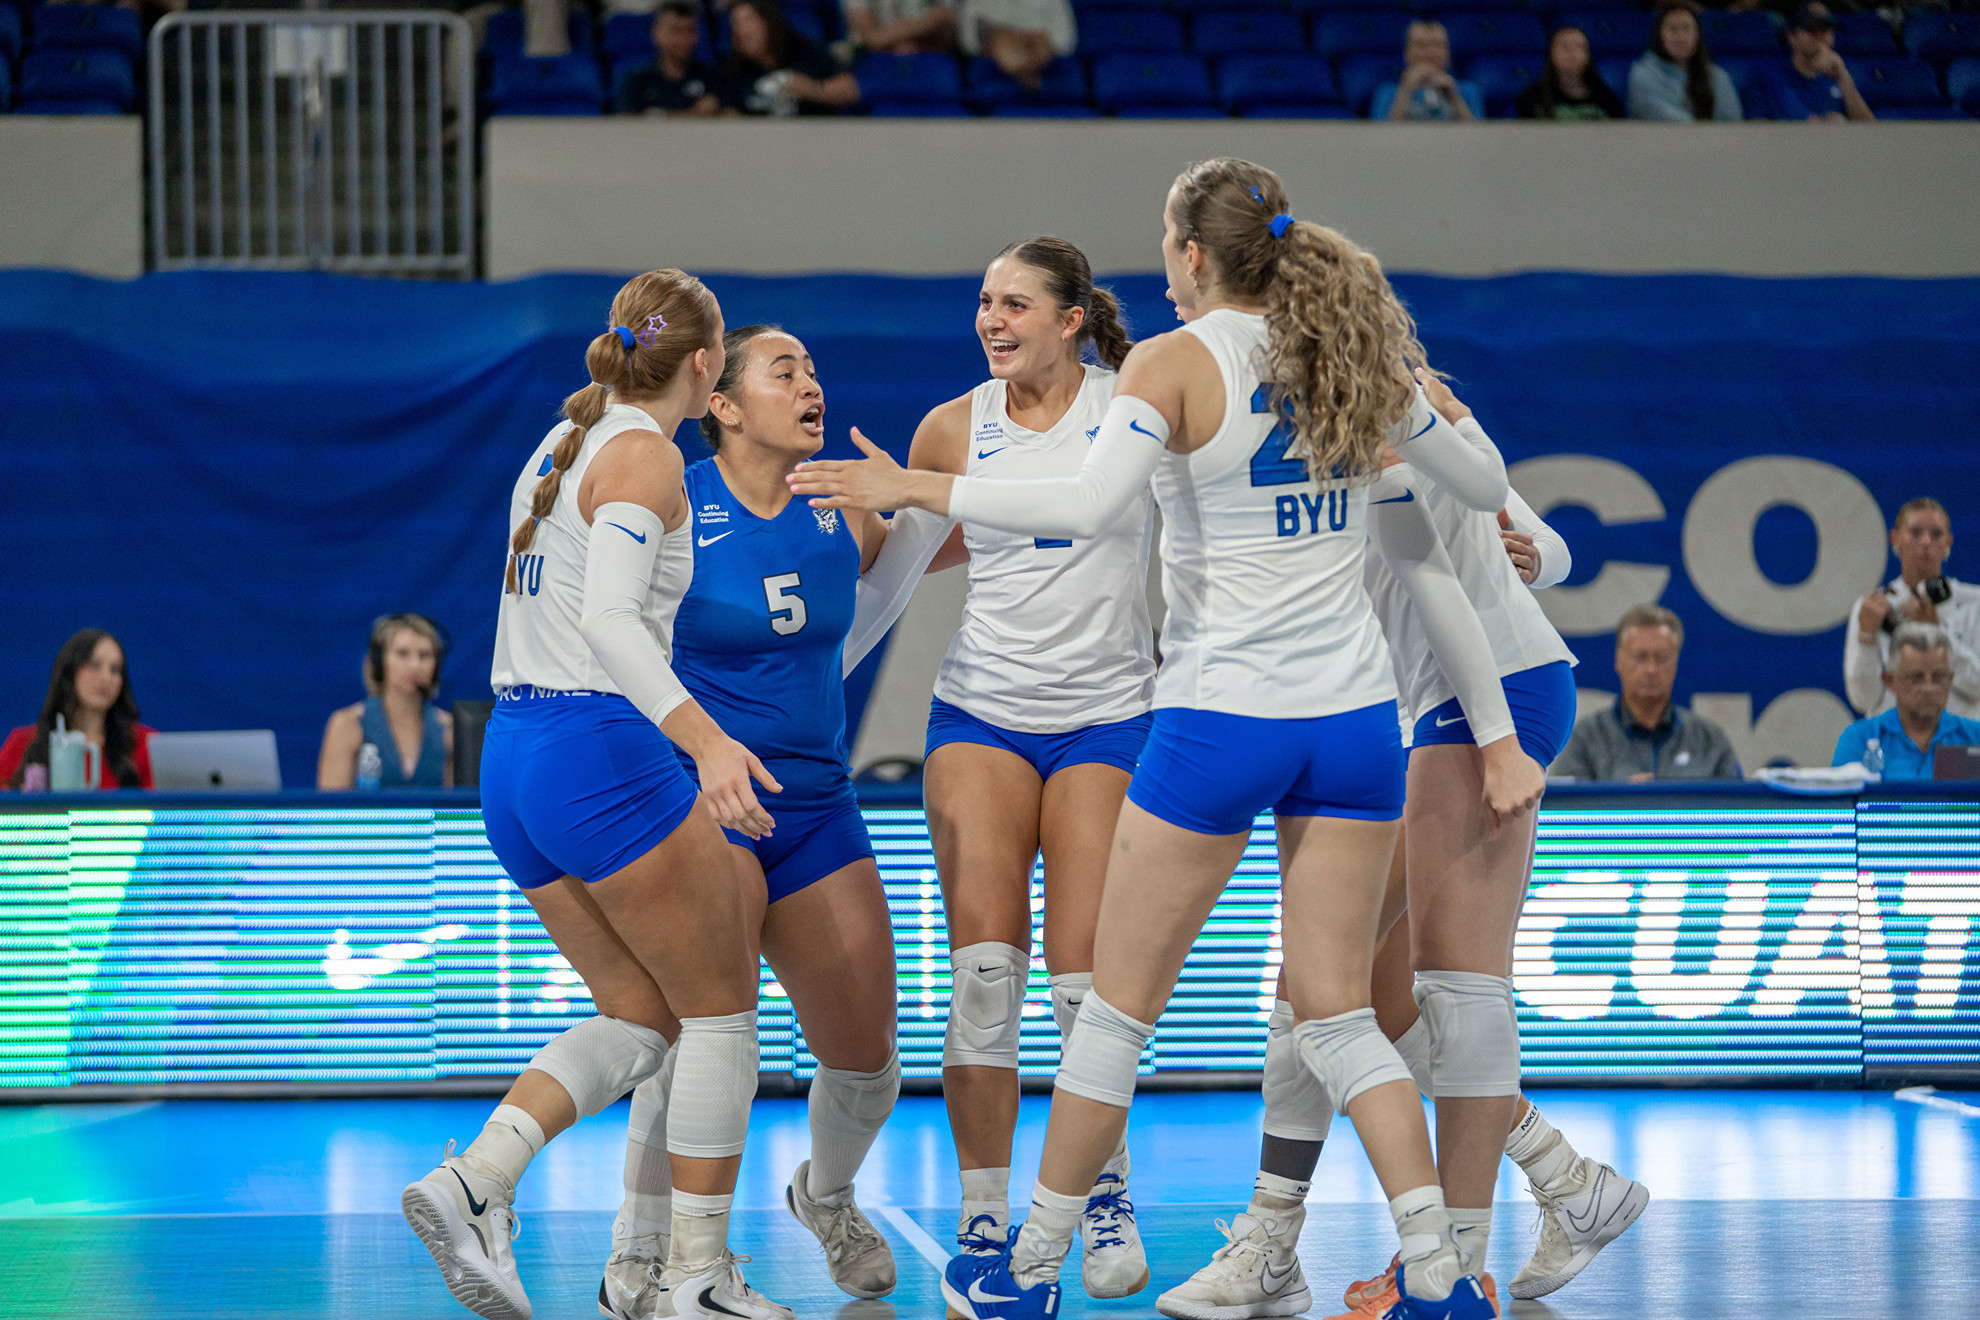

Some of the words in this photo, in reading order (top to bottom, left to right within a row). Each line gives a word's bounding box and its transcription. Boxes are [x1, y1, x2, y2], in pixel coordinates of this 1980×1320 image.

[1276, 488, 1348, 537] BYU
[505, 553, 545, 596] YU
[762, 571, 808, 636] 5
[1521, 1109, 1537, 1131] NIKE
